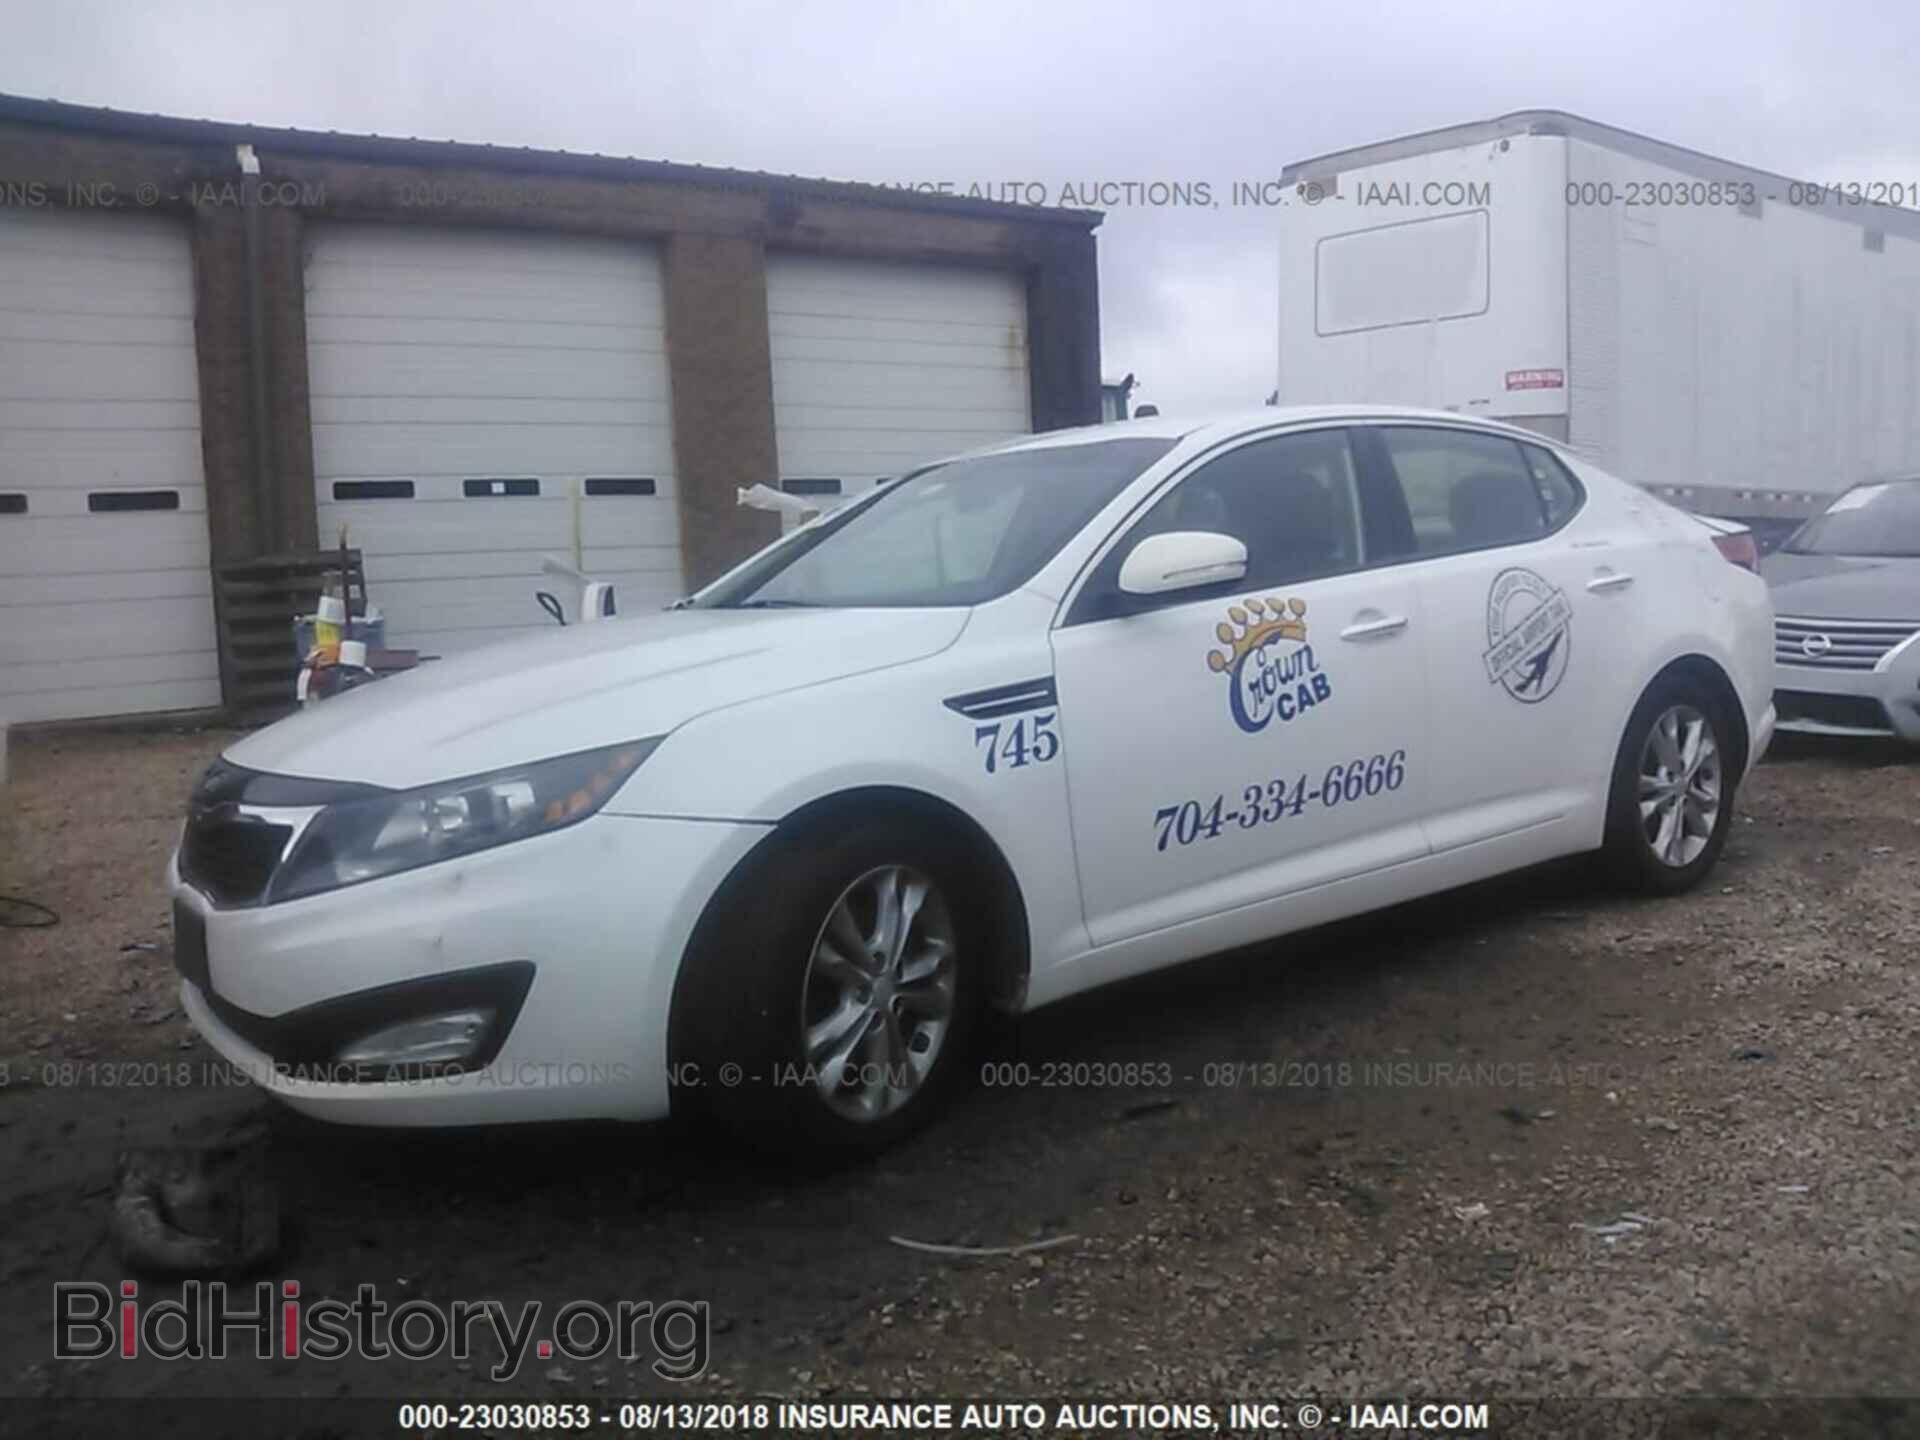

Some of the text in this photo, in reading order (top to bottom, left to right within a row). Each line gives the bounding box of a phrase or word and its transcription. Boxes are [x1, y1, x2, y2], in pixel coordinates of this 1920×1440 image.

[1230, 645, 1320, 733] Crown
[1277, 673, 1331, 721] CAB
[974, 712, 1059, 774] 745
[1153, 750, 1406, 852] 704-334-6666
